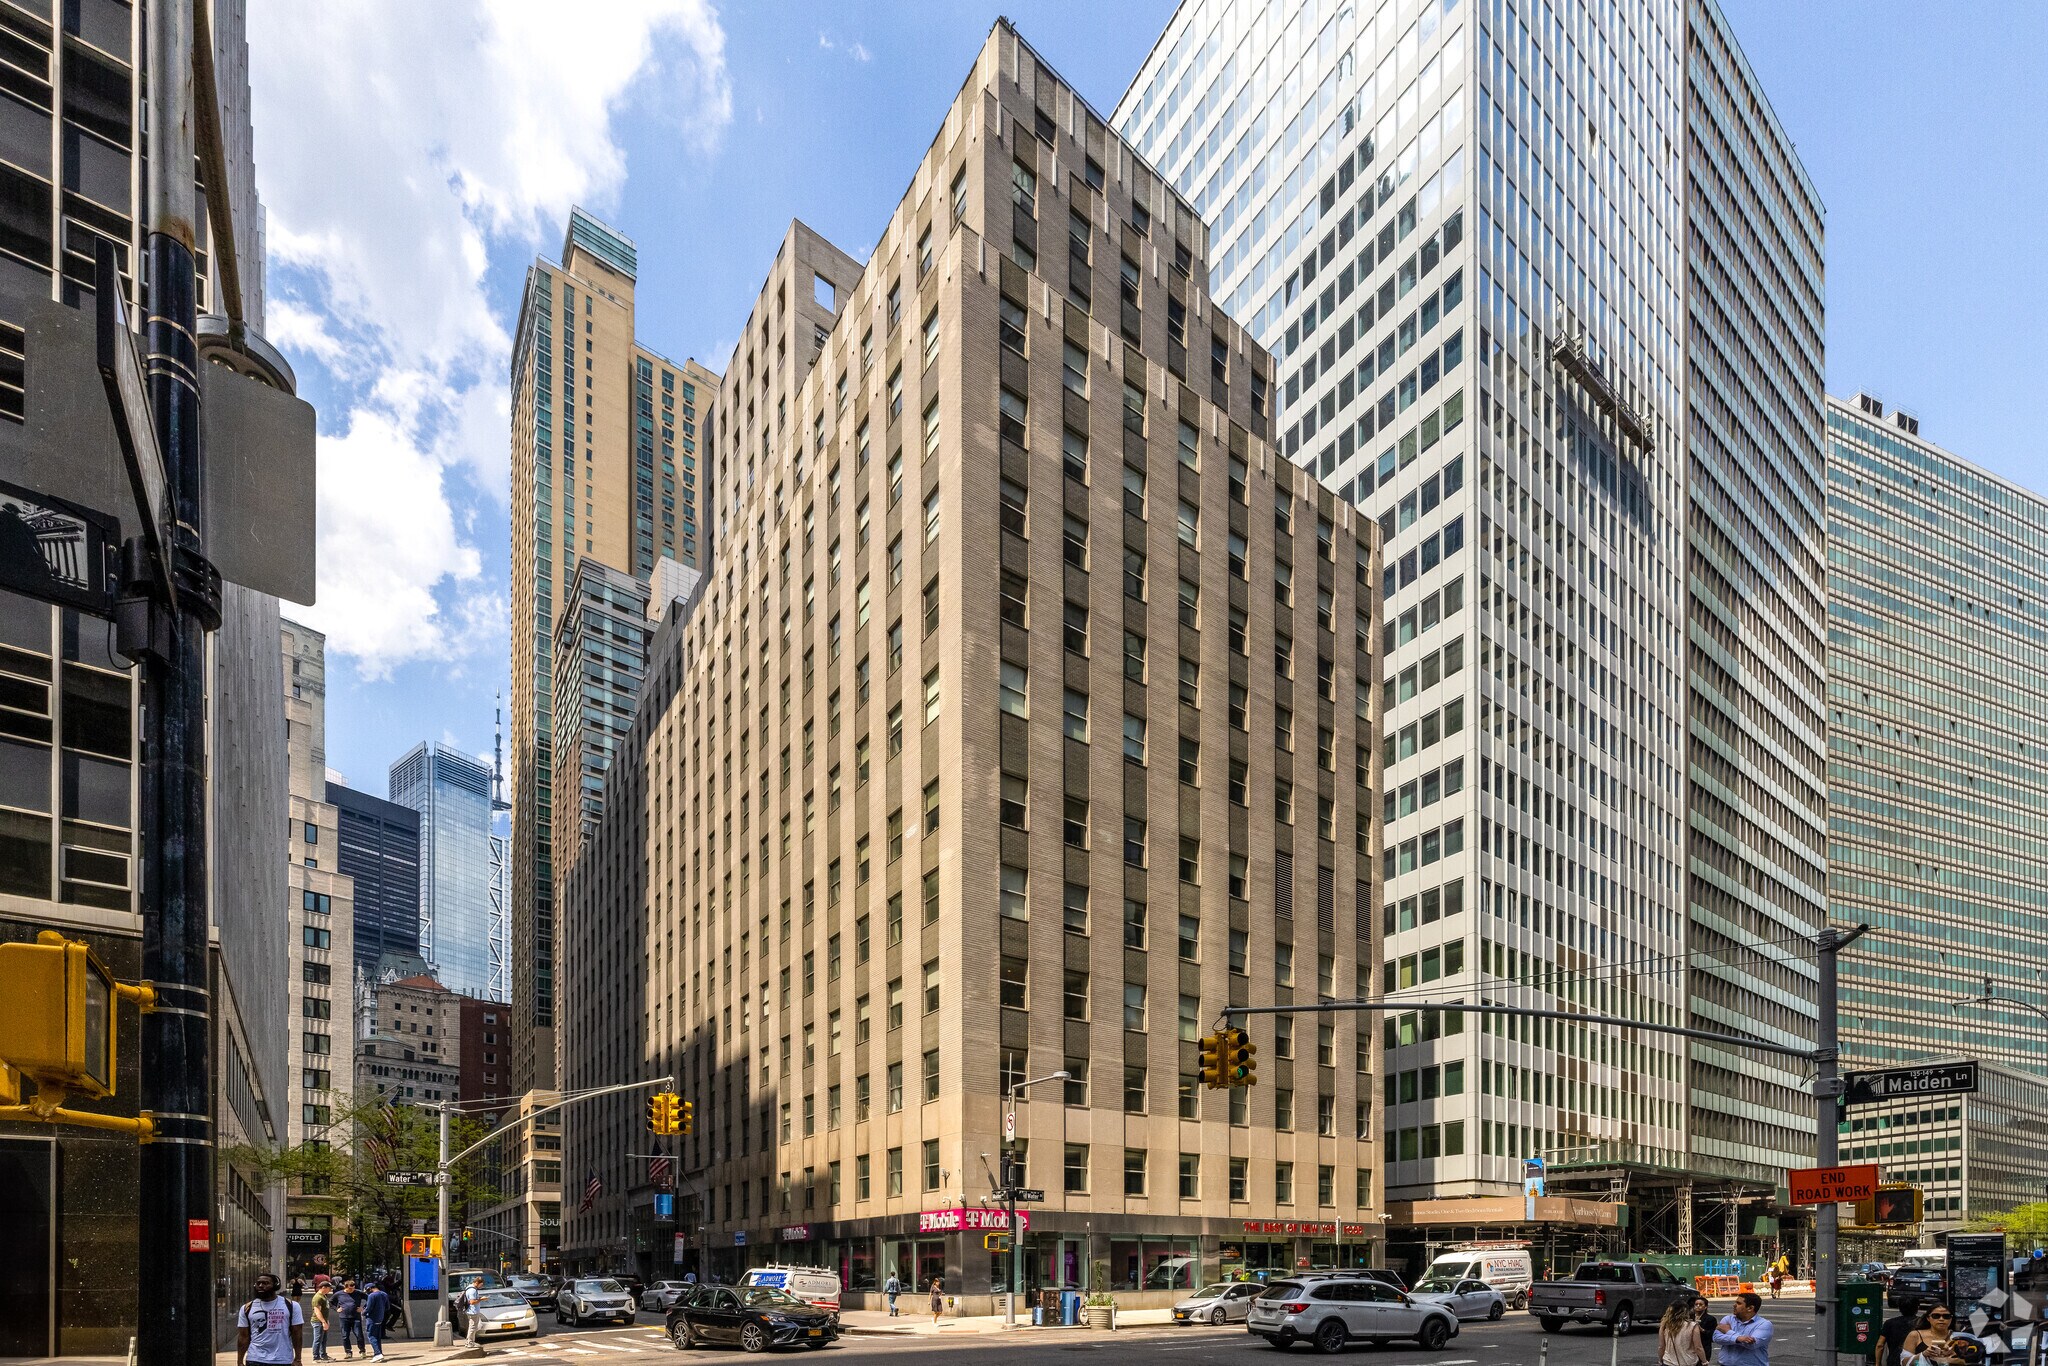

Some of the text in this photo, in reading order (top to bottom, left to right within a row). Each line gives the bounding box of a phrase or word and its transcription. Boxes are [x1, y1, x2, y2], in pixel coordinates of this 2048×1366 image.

[1889, 1072, 1968, 1092] Maiden Ln
[389, 1174, 411, 1183] Water
[1821, 1172, 1846, 1185] END
[1797, 1184, 1871, 1200] ROAD WORK
[1243, 1222, 1363, 1235] THE BEST OF NEW YOR FOOD
[419, 1241, 424, 1253] 3
[1494, 1259, 1523, 1268] NYC HVAC
